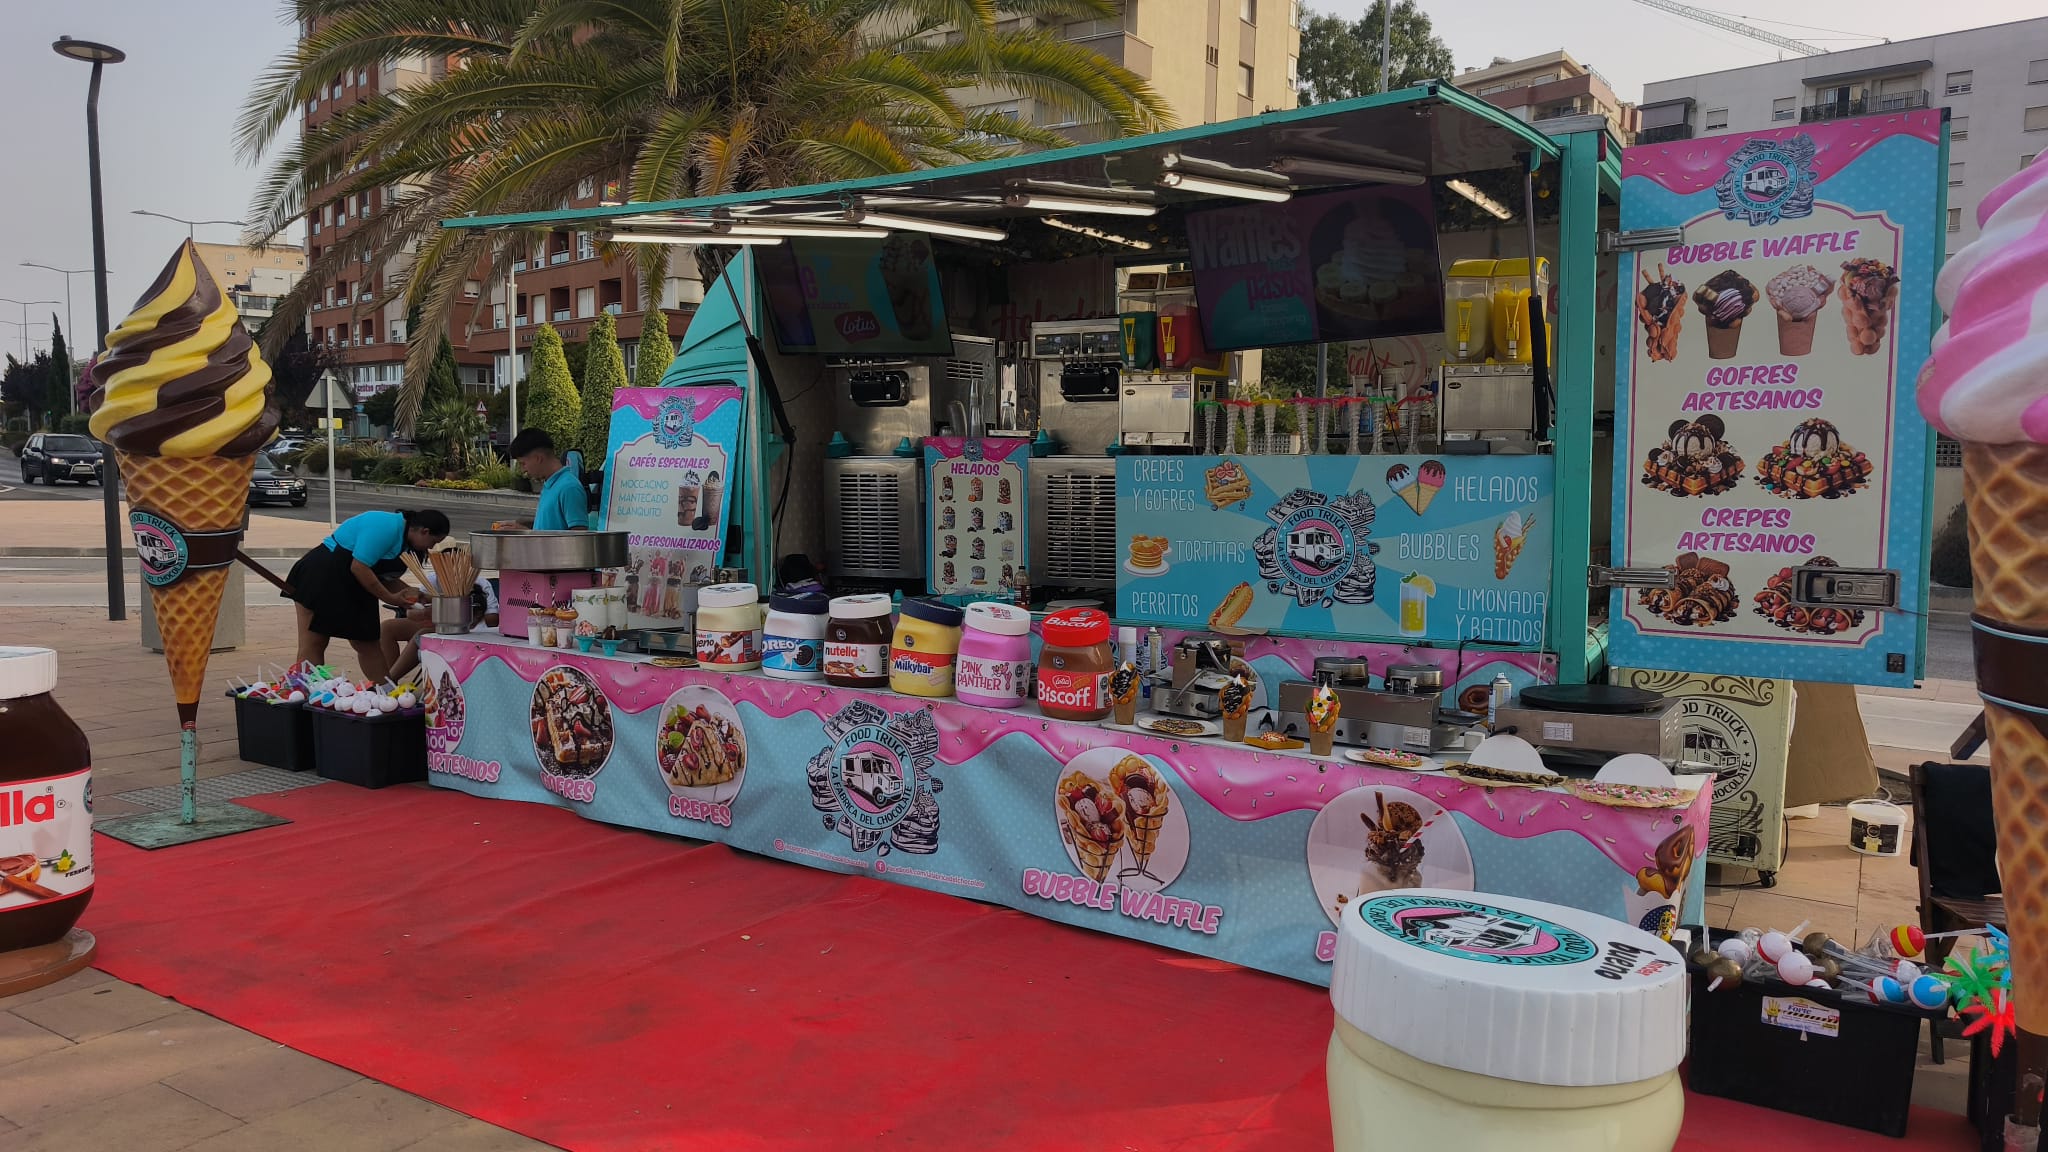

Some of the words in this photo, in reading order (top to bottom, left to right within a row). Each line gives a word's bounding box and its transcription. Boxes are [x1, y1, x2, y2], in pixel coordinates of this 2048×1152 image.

[1743, 153, 1766, 168] FOOD
[1768, 152, 1793, 168] TRUCK
[1667, 239, 1757, 266] BUBBLE
[1762, 229, 1860, 258] WAFFLE
[842, 315, 876, 335] Lotus
[1706, 364, 1799, 386] GOFRES
[1682, 388, 1824, 411] ARTESANOS
[629, 452, 656, 468] CAFÉS
[658, 457, 710, 470] ESPECIALES
[950, 462, 1000, 477] HELADOS
[1134, 459, 1184, 482] CREPES
[620, 479, 669, 490] MOCCACINO
[1455, 475, 1538, 503] HELADOS
[618, 493, 669, 503] MANTECADO
[1132, 487, 1142, 513] Y
[1144, 488, 1195, 512] GOFRES
[617, 506, 662, 517] BLANQUITO
[1288, 508, 1314, 527] FOOD
[1318, 509, 1348, 533] TRUCK
[1701, 508, 1791, 528] CREPES
[147, 516, 178, 539] TRUCK
[643, 536, 721, 551] PERSONALIZADOS
[1176, 540, 1245, 564] TORTITAS
[1277, 541, 1284, 552] LA
[1399, 532, 1480, 561] BUBBLES
[1677, 532, 1816, 554] ARTESANOS
[1279, 553, 1302, 582] FABRICA
[1320, 551, 1353, 584] CHOCOLATE
[1304, 576, 1318, 585] DEL
[1132, 592, 1198, 617] PERRITOS
[1458, 588, 1546, 615] LIMONADA
[1044, 616, 1103, 629] Biscoff
[1456, 613, 1466, 641] Y
[1470, 617, 1543, 643] BATIDOS
[761, 640, 795, 653] OREO
[824, 645, 858, 658] nutella
[893, 658, 934, 675] Milkybar
[961, 660, 983, 675] PINK
[957, 672, 1001, 691] PANTHER
[1038, 681, 1091, 707] Biscoff
[1705, 703, 1747, 739] TRUCK
[844, 727, 871, 748] FOOD
[875, 729, 907, 762] TRUCK
[427, 750, 502, 783] ARTESANOS
[831, 765, 838, 779] LA
[1712, 760, 1752, 800] HOCOLATE
[668, 793, 732, 827] CREPES
[831, 781, 858, 818] FABRICA
[876, 784, 914, 827] CHOCOLATE
[859, 813, 875, 826] DEL
[1023, 867, 1118, 911] BUBBLE
[1120, 885, 1223, 934] WAFFLE
[1593, 941, 1657, 980] bueno
